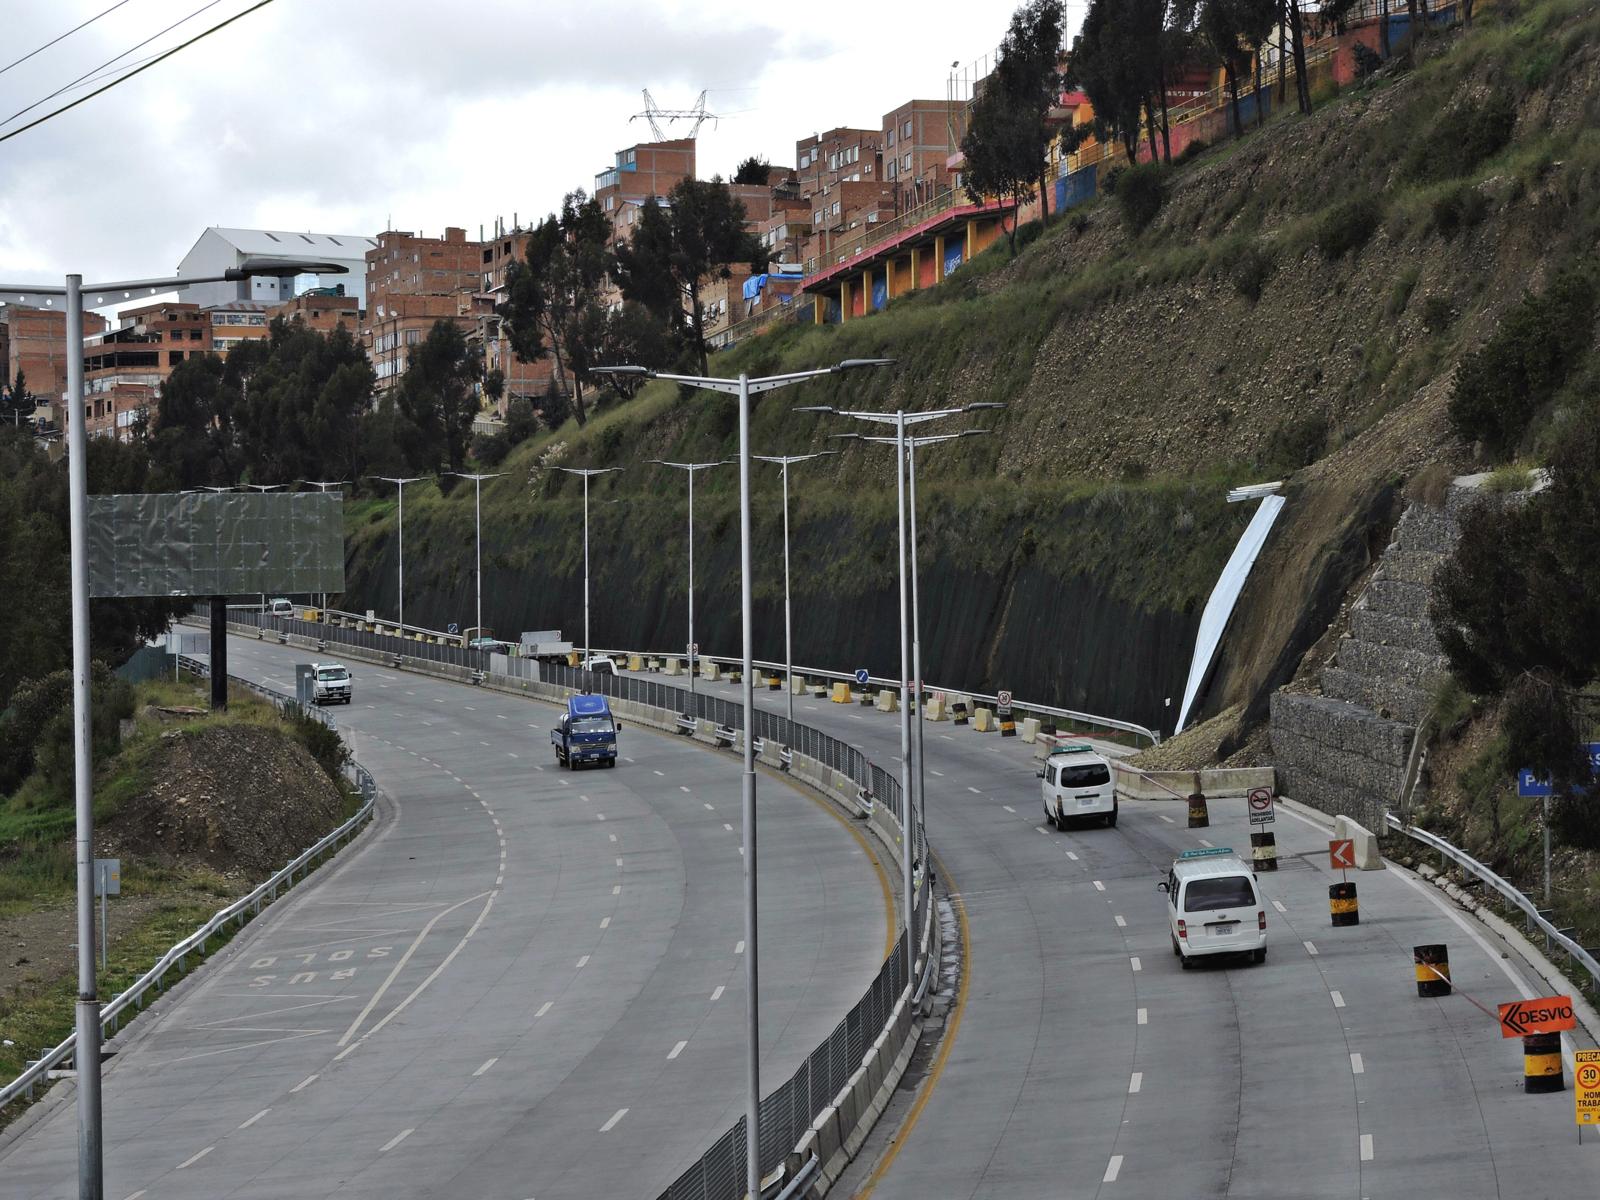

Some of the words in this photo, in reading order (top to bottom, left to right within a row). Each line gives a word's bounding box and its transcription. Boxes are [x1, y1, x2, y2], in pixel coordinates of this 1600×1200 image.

[249, 946, 393, 969] SOLO
[249, 967, 357, 988] BUS
[1518, 1006, 1573, 1025] DESVIO
[1583, 1069, 1596, 1080] 30
